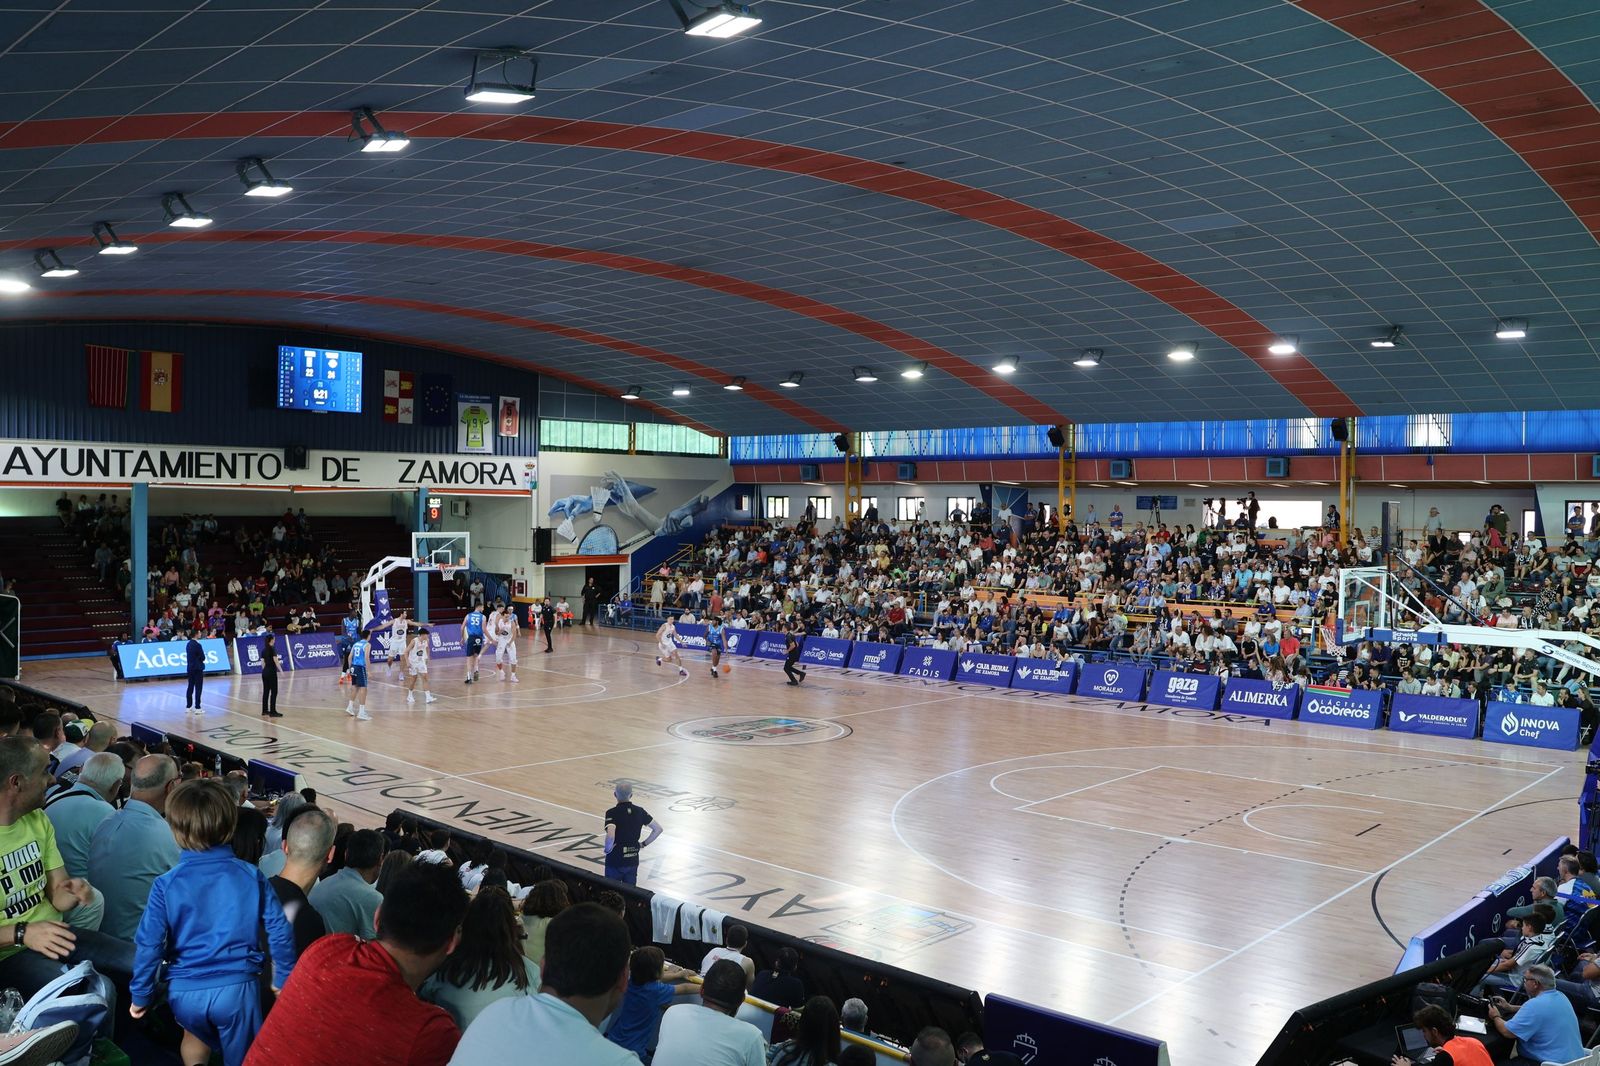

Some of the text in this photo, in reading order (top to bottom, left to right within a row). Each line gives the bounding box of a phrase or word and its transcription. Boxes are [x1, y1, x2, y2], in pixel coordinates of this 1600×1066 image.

[2, 446, 517, 486] AYUNTAMIENTO DE ZAMORA
[431, 508, 438, 519] 9
[470, 616, 480, 626] 55
[134, 647, 219, 669] Adess
[307, 649, 336, 658] ZAMORA
[909, 667, 940, 678] FADIS
[1033, 668, 1047, 676] CAJA
[1093, 685, 1124, 693] MORALEJO
[1168, 677, 1199, 693] gaza
[1229, 690, 1288, 706] ALIMERKA
[1319, 705, 1370, 719] cobreros
[1418, 713, 1468, 723] VALDERADUEY
[1520, 717, 1560, 731] INNOVA
[1519, 728, 1540, 739] Chef
[0, 840, 41, 873] UMA
